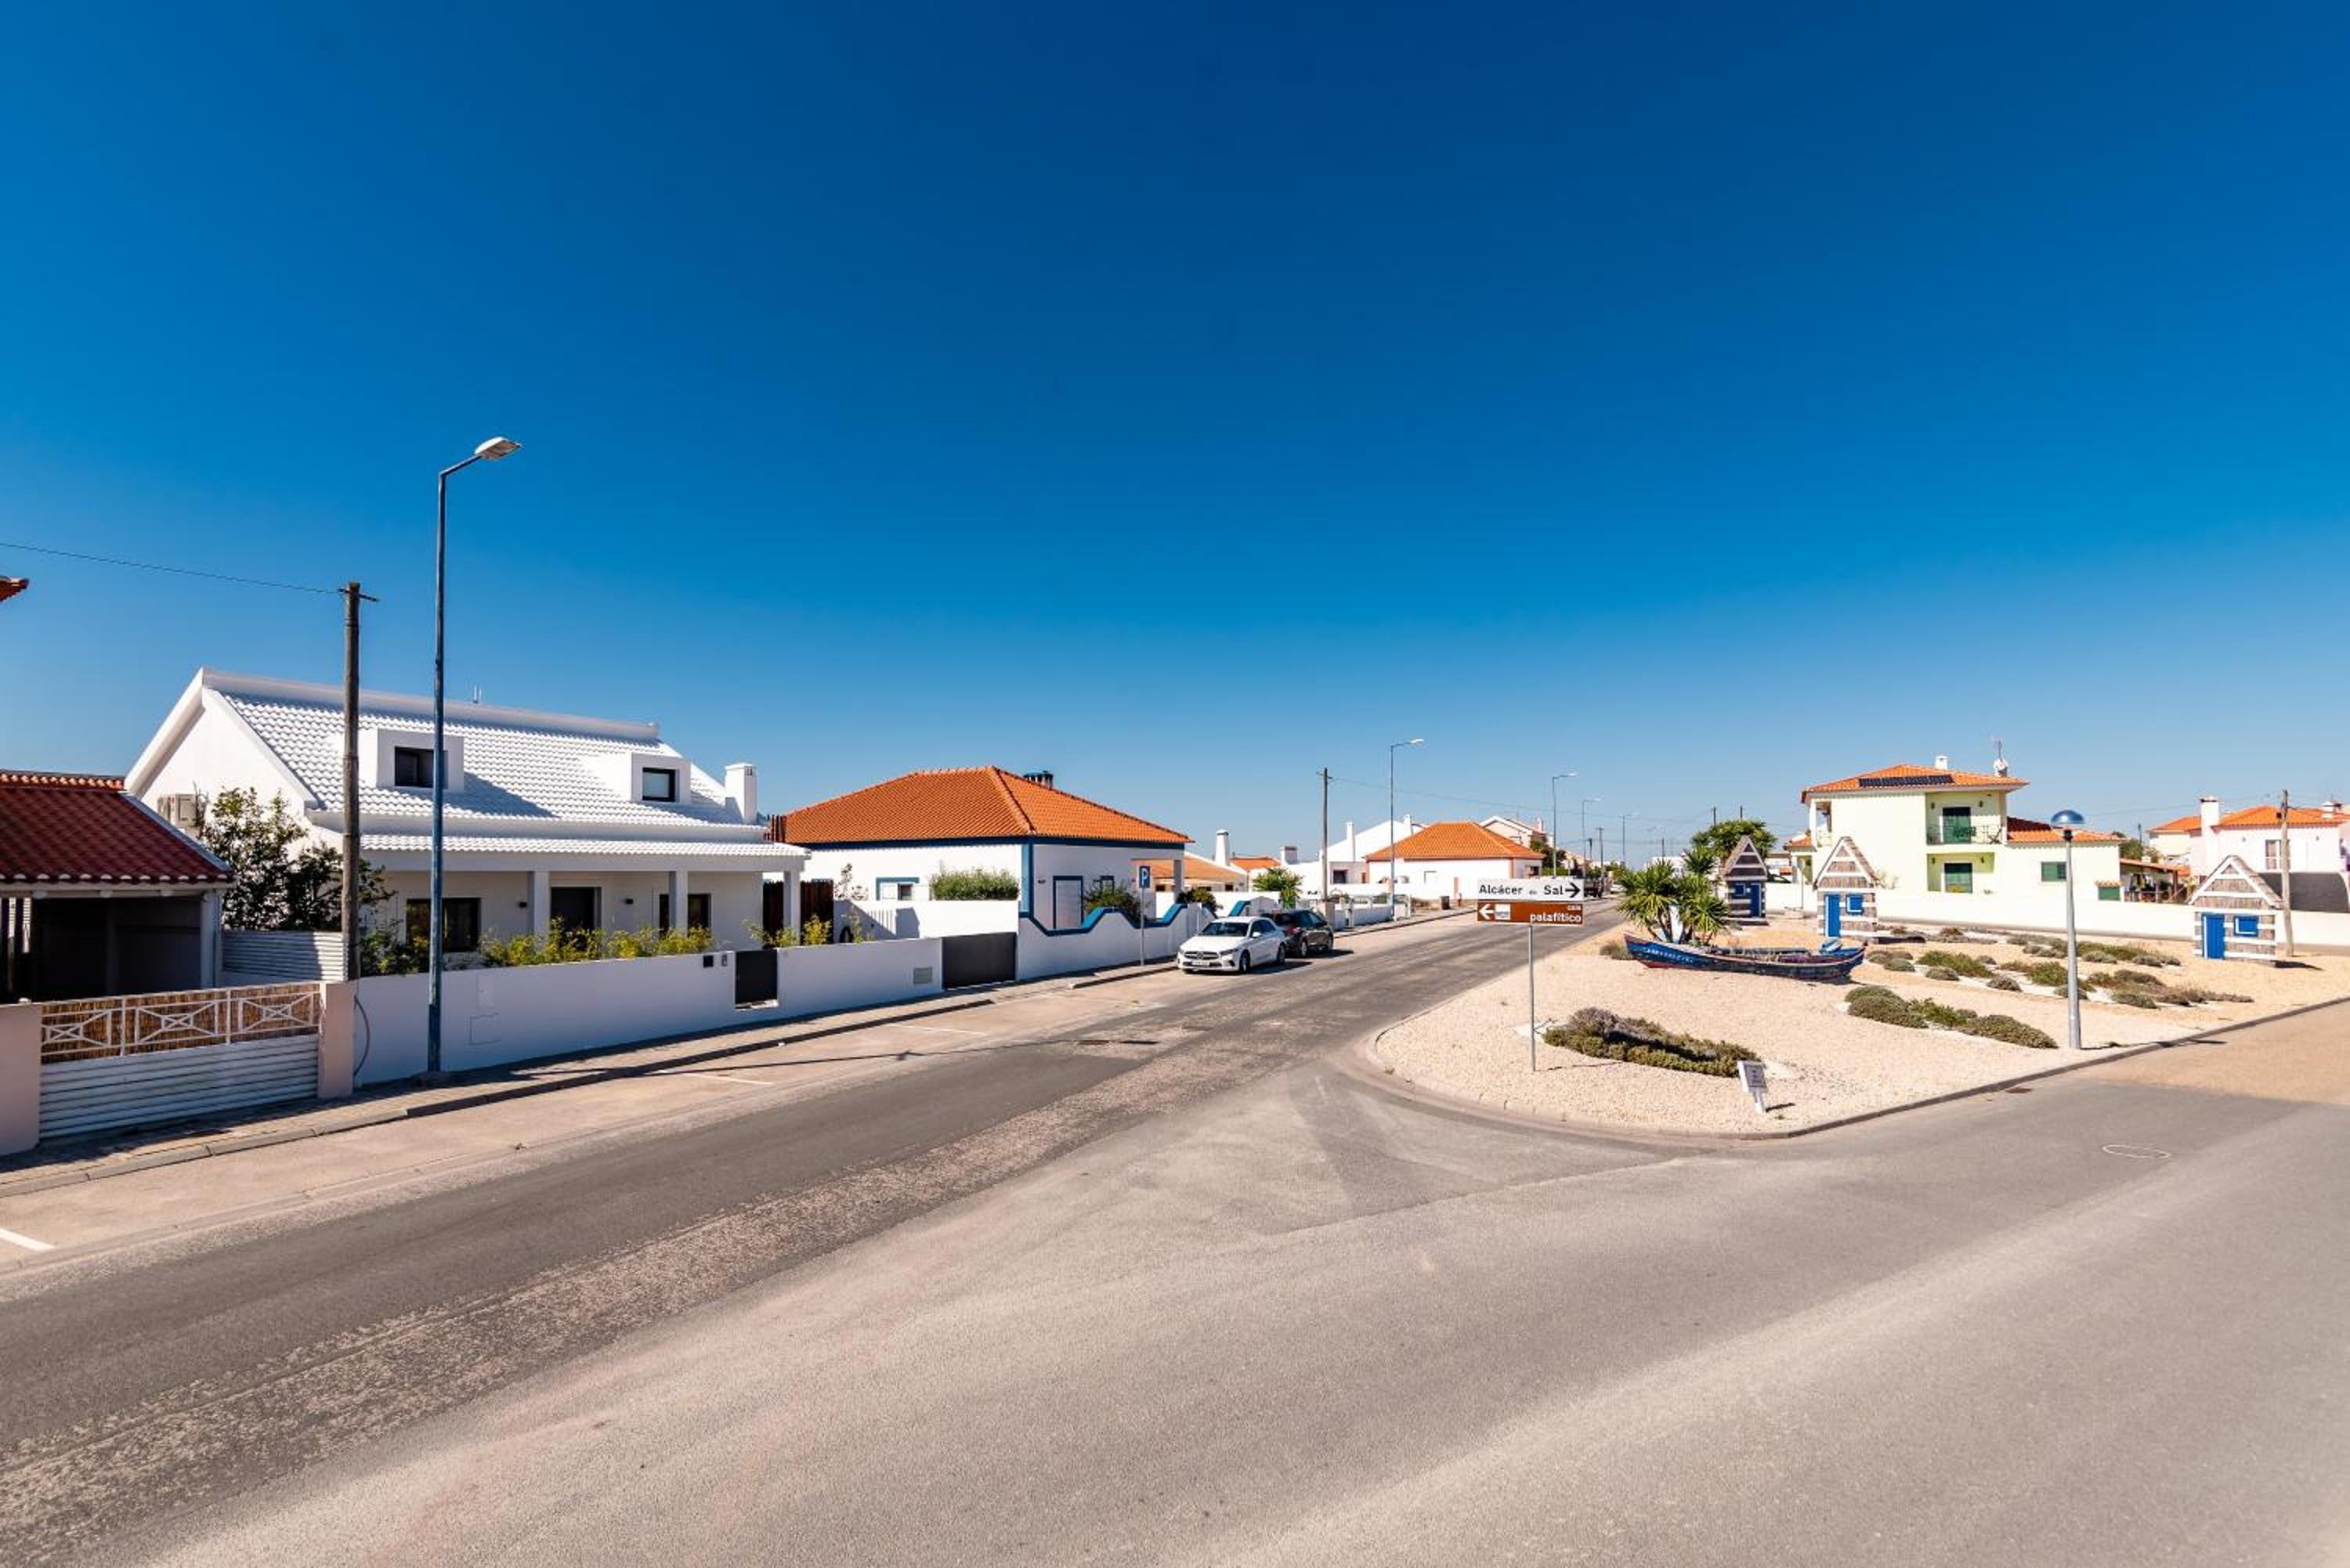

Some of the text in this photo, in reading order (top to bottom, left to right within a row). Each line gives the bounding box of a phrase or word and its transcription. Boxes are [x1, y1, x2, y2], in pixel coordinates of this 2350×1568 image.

[1141, 867, 1148, 886] P
[1479, 884, 1523, 894] Alcácer
[1544, 884, 1563, 895] Sal
